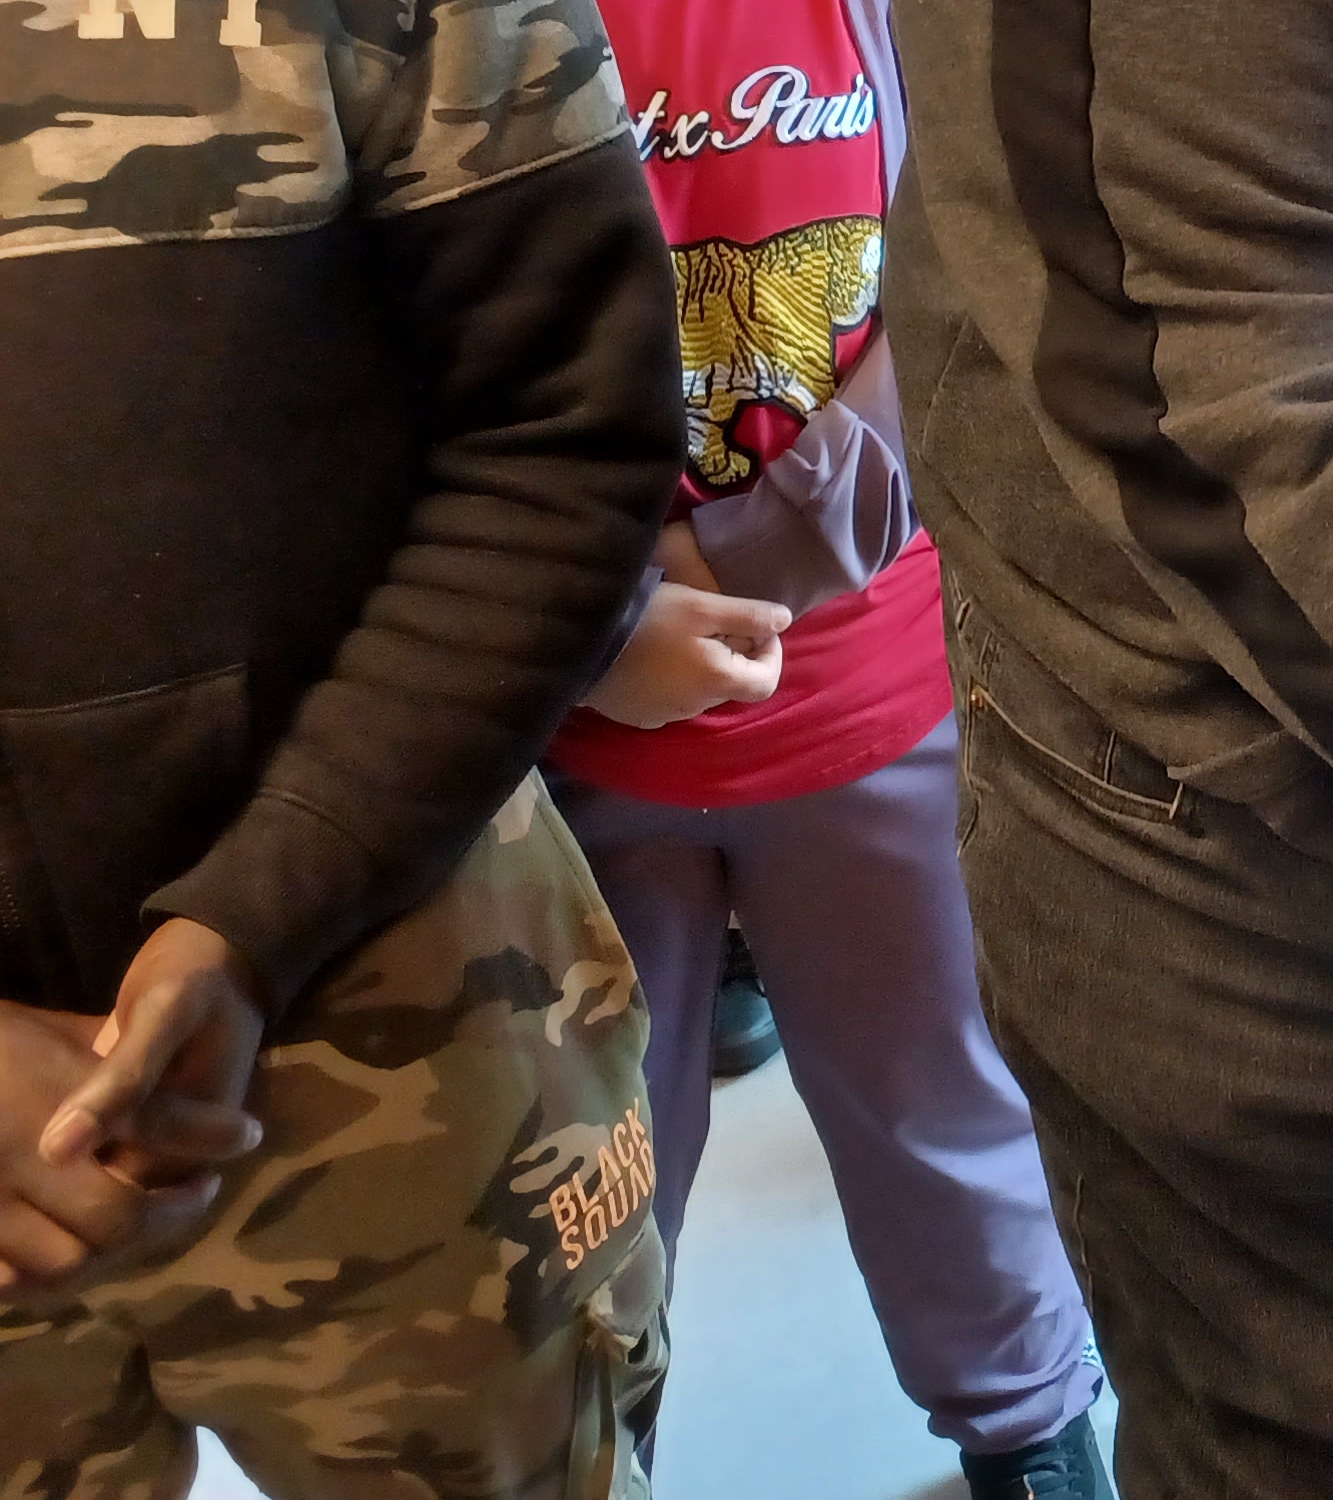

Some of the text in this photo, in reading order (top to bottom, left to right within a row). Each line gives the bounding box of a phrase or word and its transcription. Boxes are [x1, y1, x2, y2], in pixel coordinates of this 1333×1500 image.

[711, 64, 875, 151] Paris
[549, 1096, 646, 1233] BLACK
[561, 1138, 656, 1271] SQUAD
